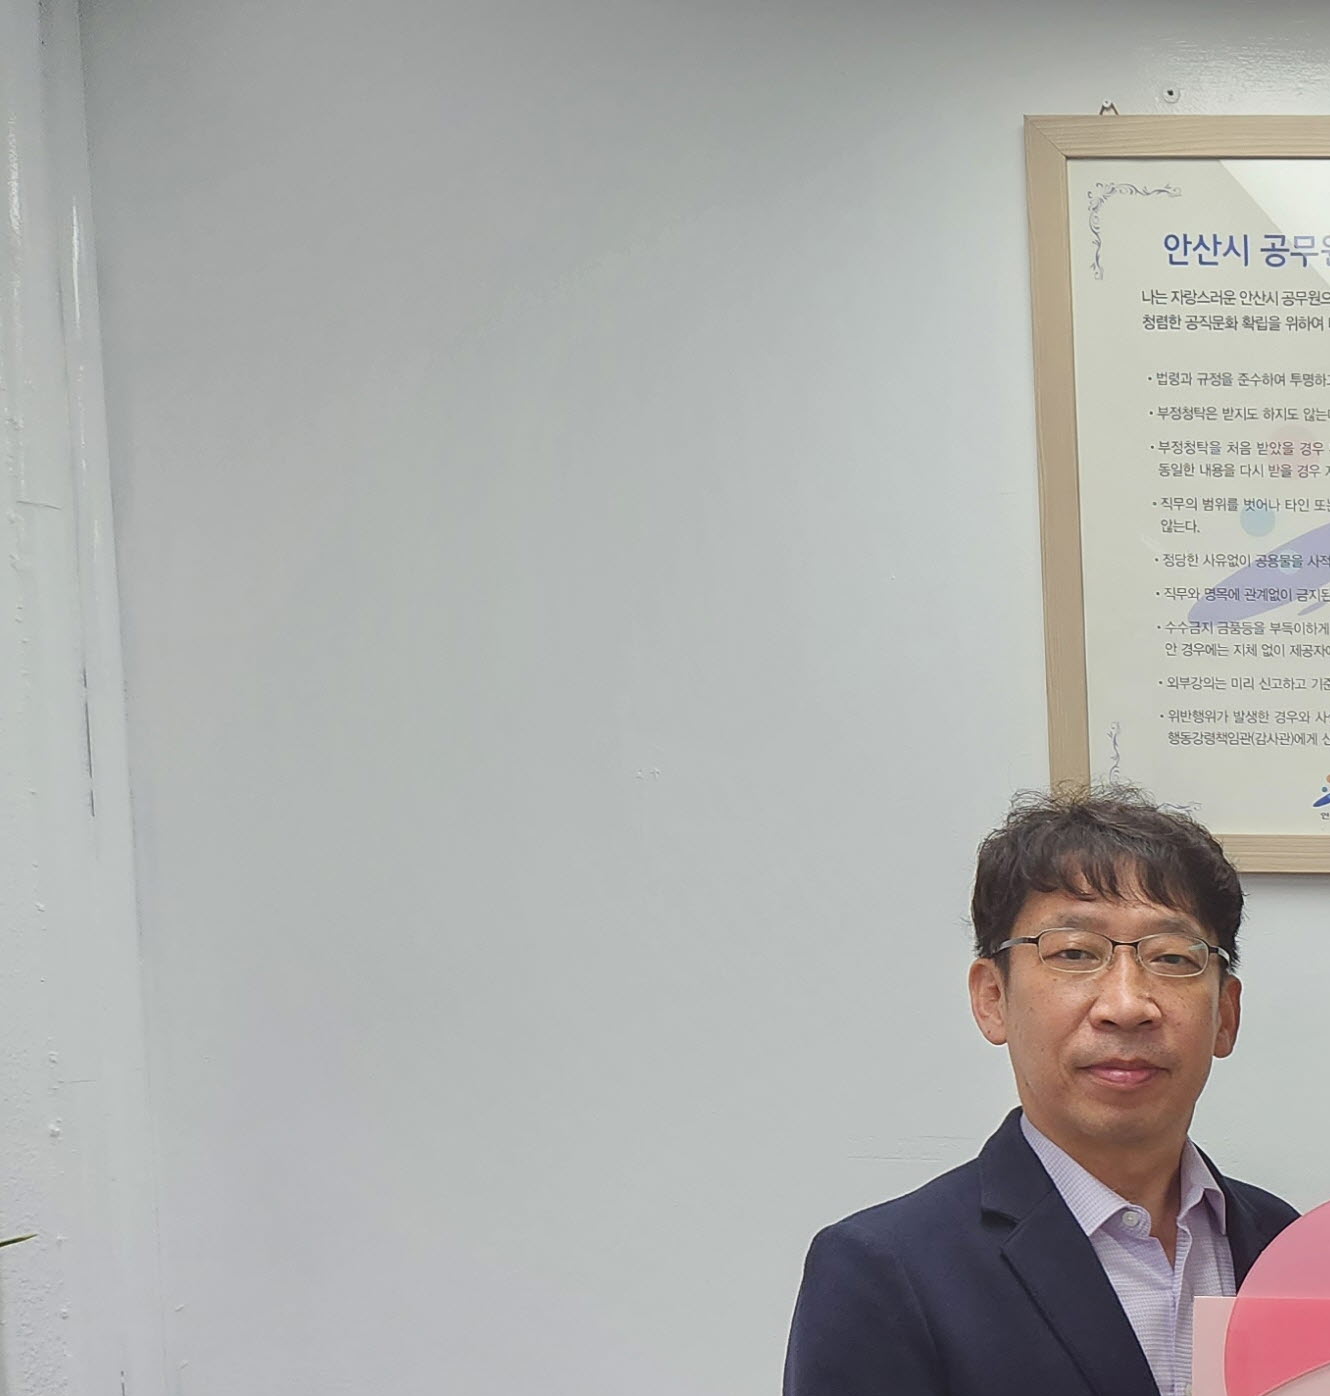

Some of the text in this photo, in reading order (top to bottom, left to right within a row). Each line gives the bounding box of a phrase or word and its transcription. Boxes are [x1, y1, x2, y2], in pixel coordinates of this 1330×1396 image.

[1163, 233, 1249, 267] 안산시
[1142, 289, 1168, 305] 나는
[1171, 289, 1236, 306] 자랑스러운
[1239, 290, 1279, 306] 안산시
[1142, 314, 1182, 331] 청렴한
[1185, 315, 1238, 331] 공직문화
[1242, 315, 1281, 331] 확립을
[1285, 316, 1324, 332] 위하여
[1156, 371, 1192, 387] 법령과
[1196, 372, 1234, 387] 규정을
[1237, 372, 1286, 387] 준수하여
[1157, 406, 1218, 421] 부정청탁은
[1222, 406, 1258, 422] 받지도
[1262, 407, 1299, 422] 하지도
[1158, 440, 1222, 456] 부정청탁을
[1226, 441, 1252, 456] 처음
[1257, 441, 1295, 456] 받았을
[1299, 441, 1325, 456] 경우
[1158, 462, 1195, 477] 동일한
[1199, 463, 1236, 478] 내용을
[1240, 463, 1264, 478] 다시
[1268, 463, 1293, 478] 받을
[1297, 464, 1322, 479] 경우
[1160, 496, 1198, 512] 직무의
[1202, 497, 1239, 512] 범위를
[1243, 497, 1280, 512] 벗어나
[1285, 498, 1310, 513] 타인
[1161, 518, 1201, 534] 않는다.
[1162, 553, 1198, 568] 정당한
[1202, 553, 1251, 569] 사유없이
[1255, 554, 1304, 569] 공용물을
[1163, 587, 1200, 602] 직무와
[1204, 587, 1240, 602] 명목에
[1244, 587, 1292, 603] 관계없이
[1164, 621, 1213, 635] 수수금지
[1217, 621, 1266, 636] 금품등을
[1269, 622, 1329, 636] 부득이하게
[1165, 642, 1177, 657] 안
[1181, 642, 1230, 657] 경우에는
[1233, 643, 1258, 658] 지체
[1261, 643, 1285, 658] 없이
[1166, 676, 1227, 691] 외부강의는
[1231, 676, 1254, 691] 미리
[1259, 676, 1307, 691] 신고하고
[1168, 709, 1229, 724] 위반행위가
[1233, 710, 1269, 724] 발생한
[1274, 710, 1310, 725] 경우와
[1168, 731, 1318, 746] 행동강령책임관(감사관)에게
